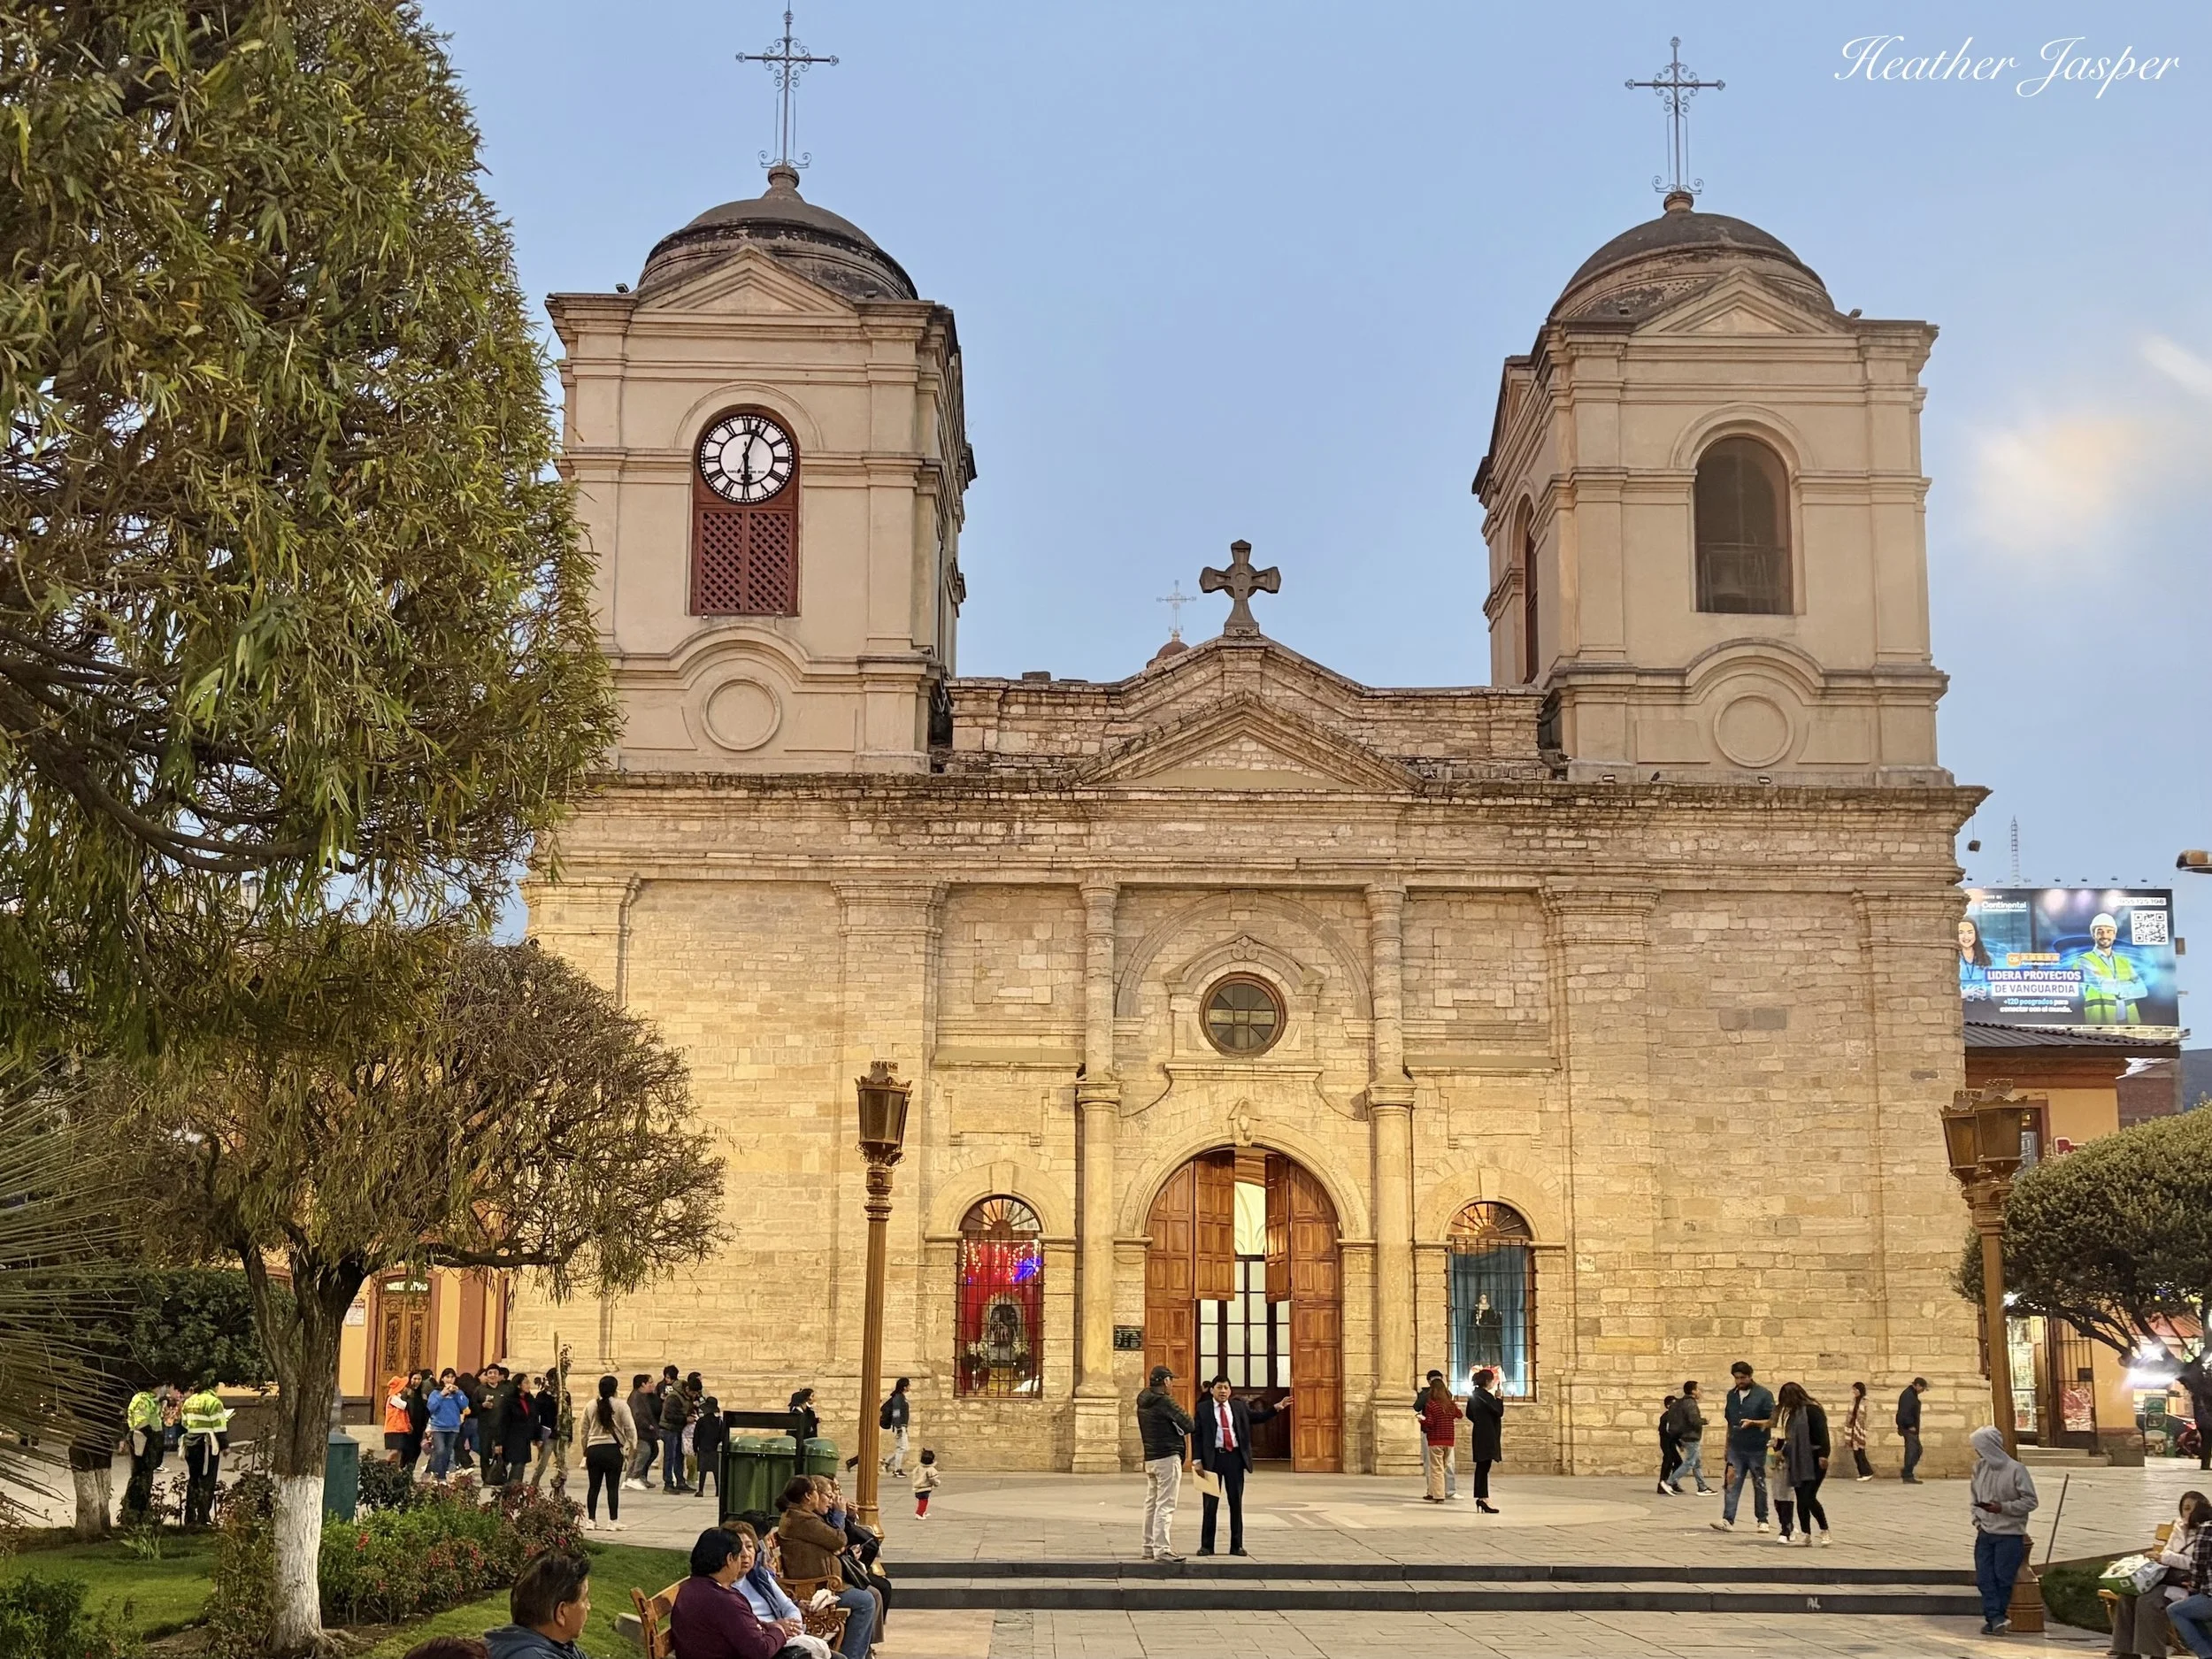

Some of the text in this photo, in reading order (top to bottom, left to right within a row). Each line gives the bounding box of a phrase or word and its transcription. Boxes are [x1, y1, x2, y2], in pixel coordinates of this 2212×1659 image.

[1987, 970, 2082, 980] LIDERA PROYECTOS
[1994, 984, 2076, 994] DE VANGUARDIA
